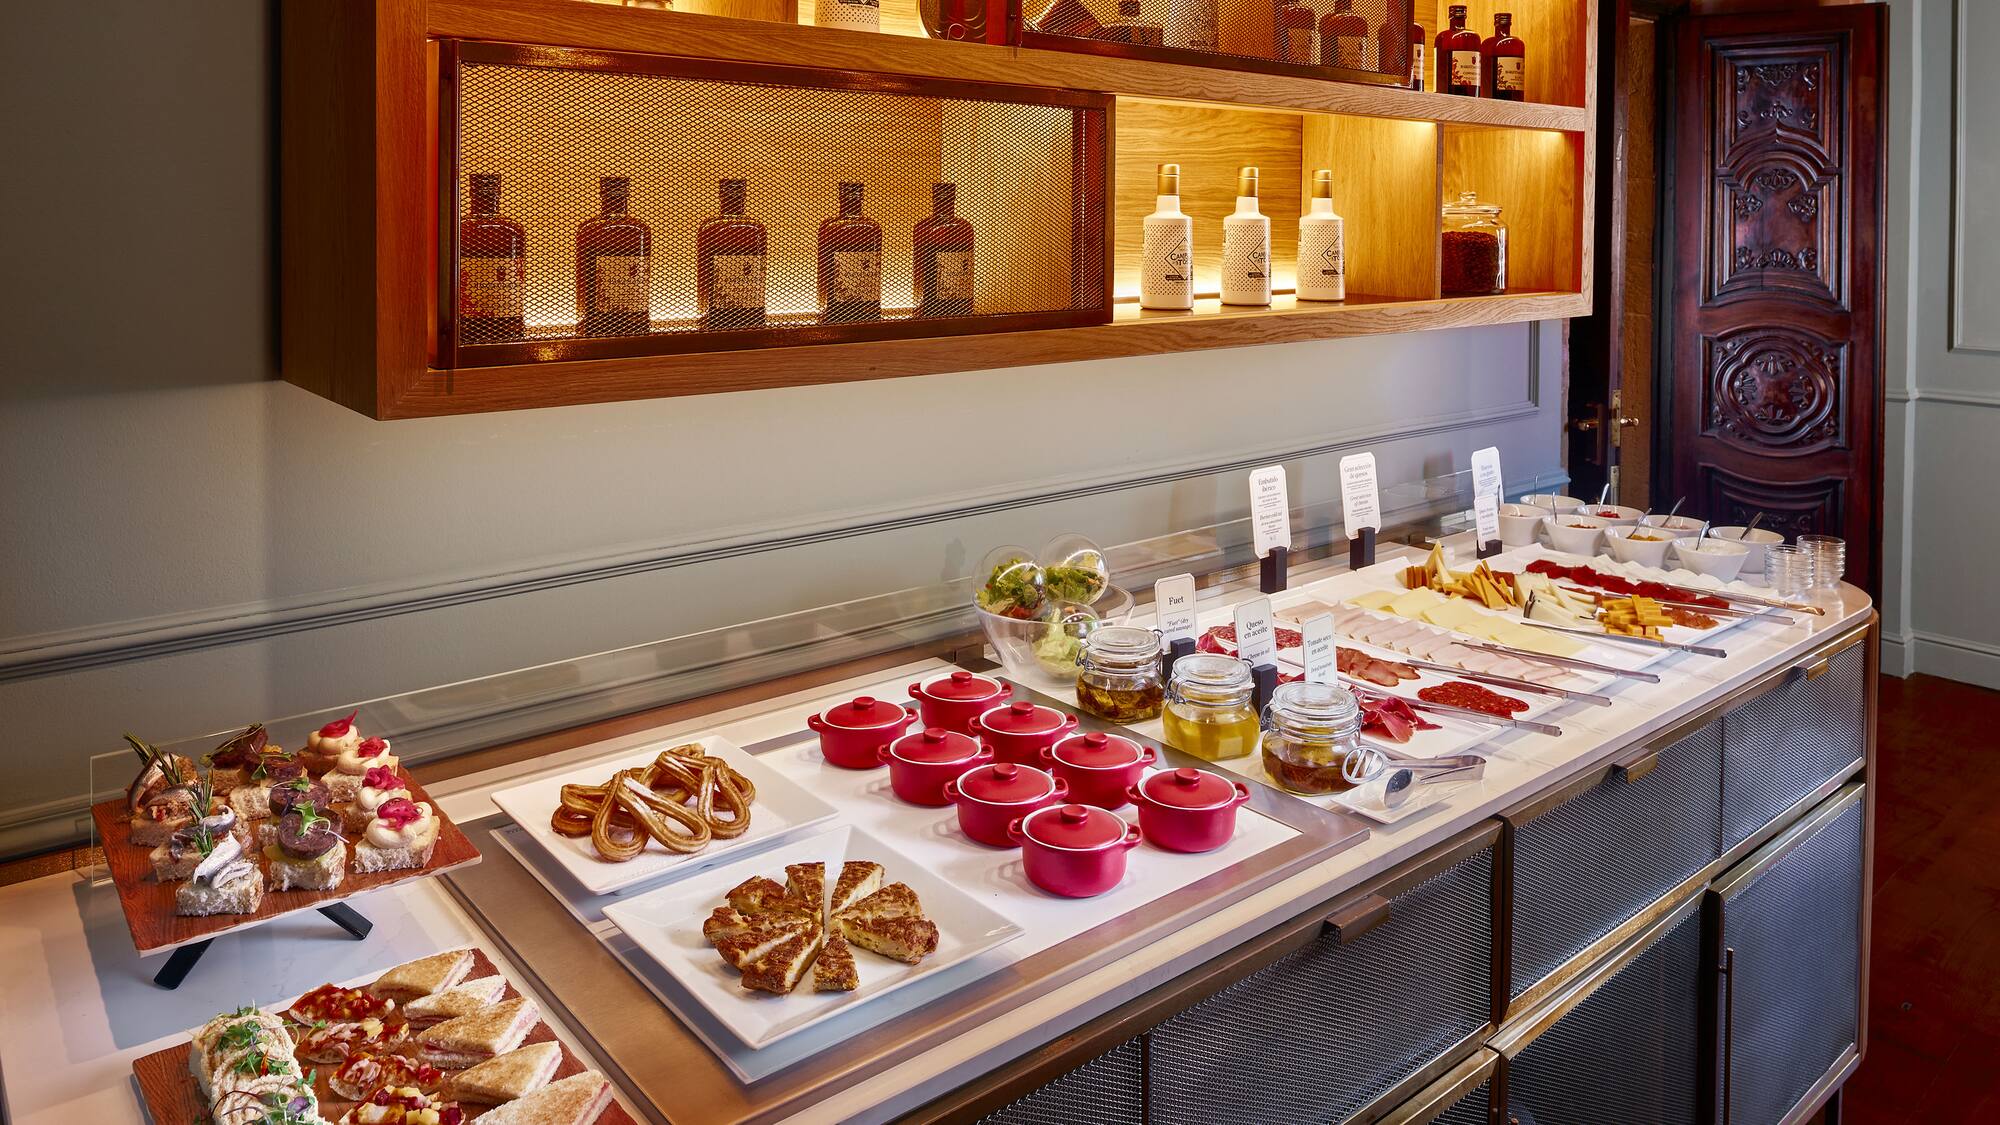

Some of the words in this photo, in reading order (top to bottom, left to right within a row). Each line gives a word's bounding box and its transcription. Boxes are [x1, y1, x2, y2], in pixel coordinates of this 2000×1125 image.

[1168, 596, 1184, 606] Fuet
[1246, 619, 1264, 631] Queso
[1251, 626, 1268, 637] aceite
[1307, 637, 1323, 648] Tomate
